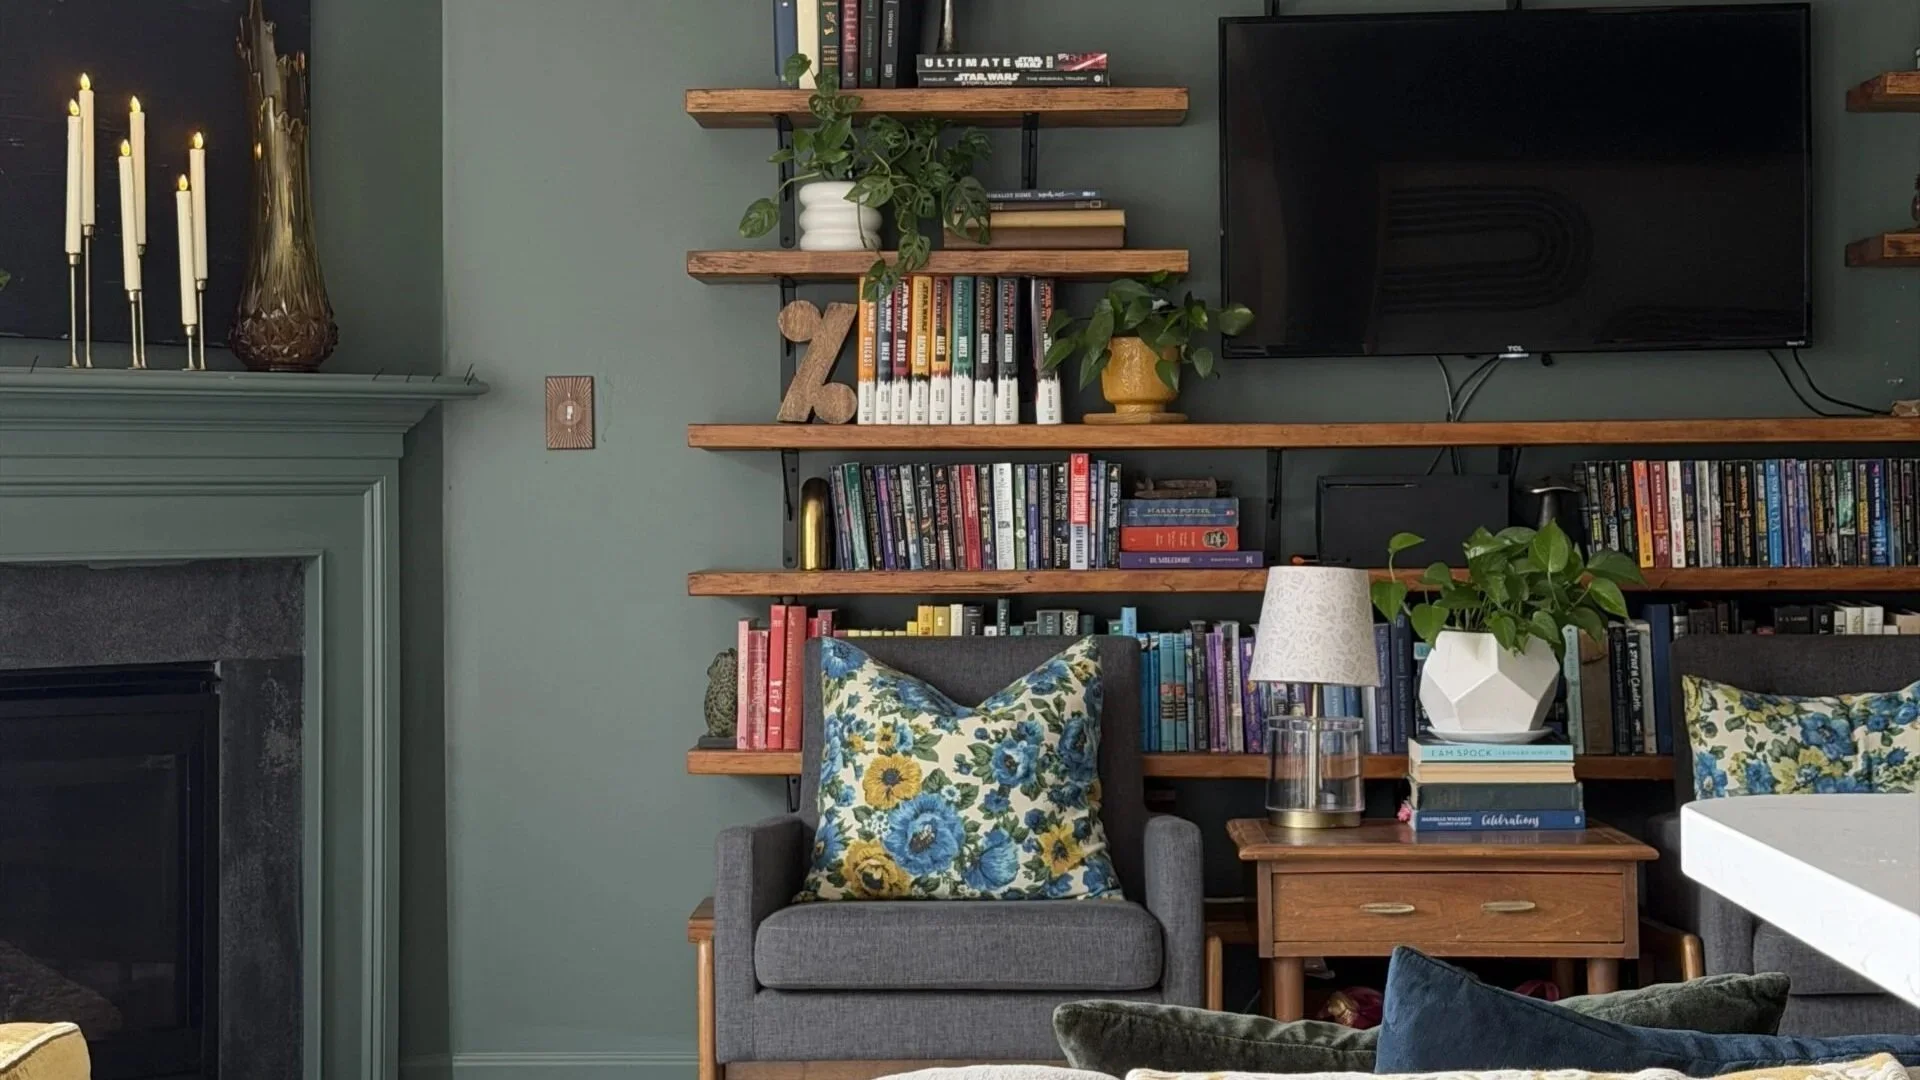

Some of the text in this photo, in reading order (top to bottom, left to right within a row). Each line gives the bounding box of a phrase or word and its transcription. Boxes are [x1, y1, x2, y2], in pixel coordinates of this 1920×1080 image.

[925, 57, 1011, 68] ULTIMATE
[954, 73, 1020, 81] STAR WARS
[896, 339, 906, 362] ABYSS
[917, 335, 926, 366] BACKLASH
[936, 336, 945, 355] ALLIES
[958, 336, 968, 358] VORTEX
[981, 333, 989, 364] CONVICTION
[1004, 334, 1013, 362] ASCENSION
[939, 483, 948, 504] STAR
[1073, 476, 1088, 521] JOHN GRISHAM
[941, 506, 949, 525] TREK
[922, 537, 930, 566] GRISHAM
[1629, 677, 1641, 711] Charlotte
[1457, 749, 1492, 757] SPOCK
[1481, 814, 1539, 827] Celebrations
